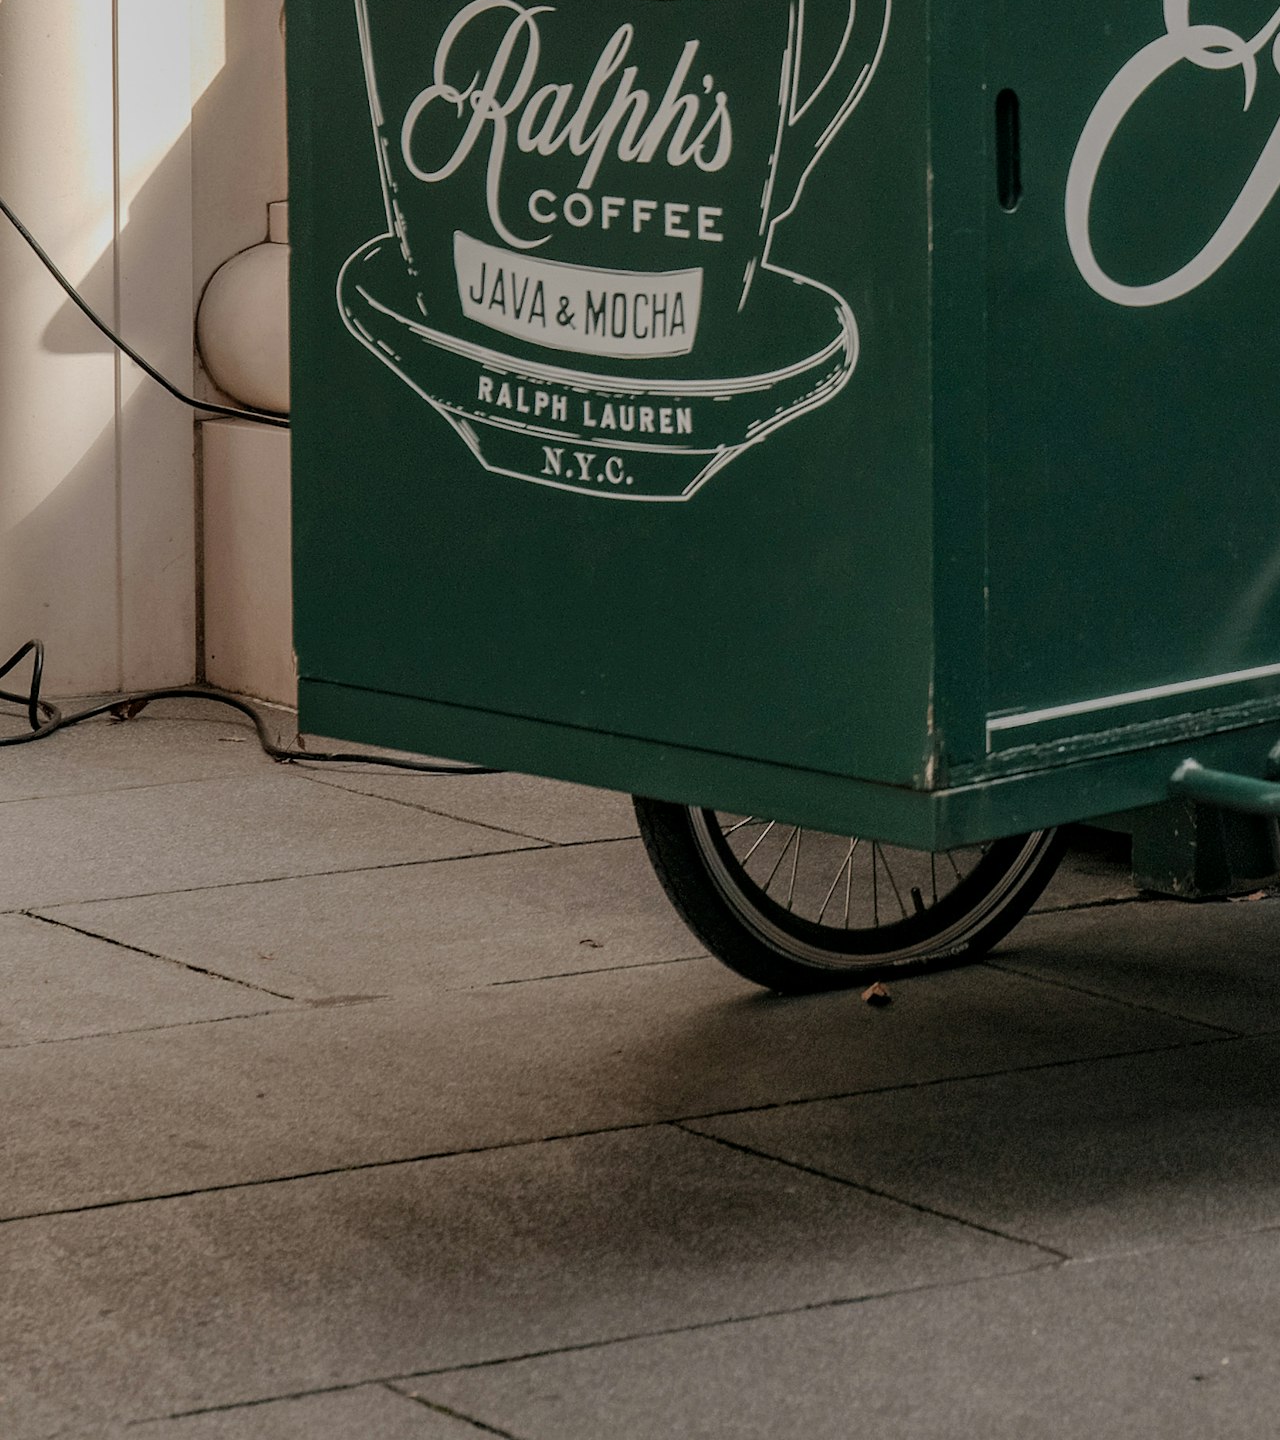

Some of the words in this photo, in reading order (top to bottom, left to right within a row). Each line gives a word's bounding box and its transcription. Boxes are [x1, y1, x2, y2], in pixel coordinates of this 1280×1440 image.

[527, 188, 724, 242] COFFEE
[468, 261, 546, 330] JAVA
[557, 296, 576, 328] &
[584, 291, 687, 340] MOCHA
[477, 375, 568, 422] RALPH
[582, 399, 693, 435] LAUREN
[541, 444, 634, 487] N.Y.C.
